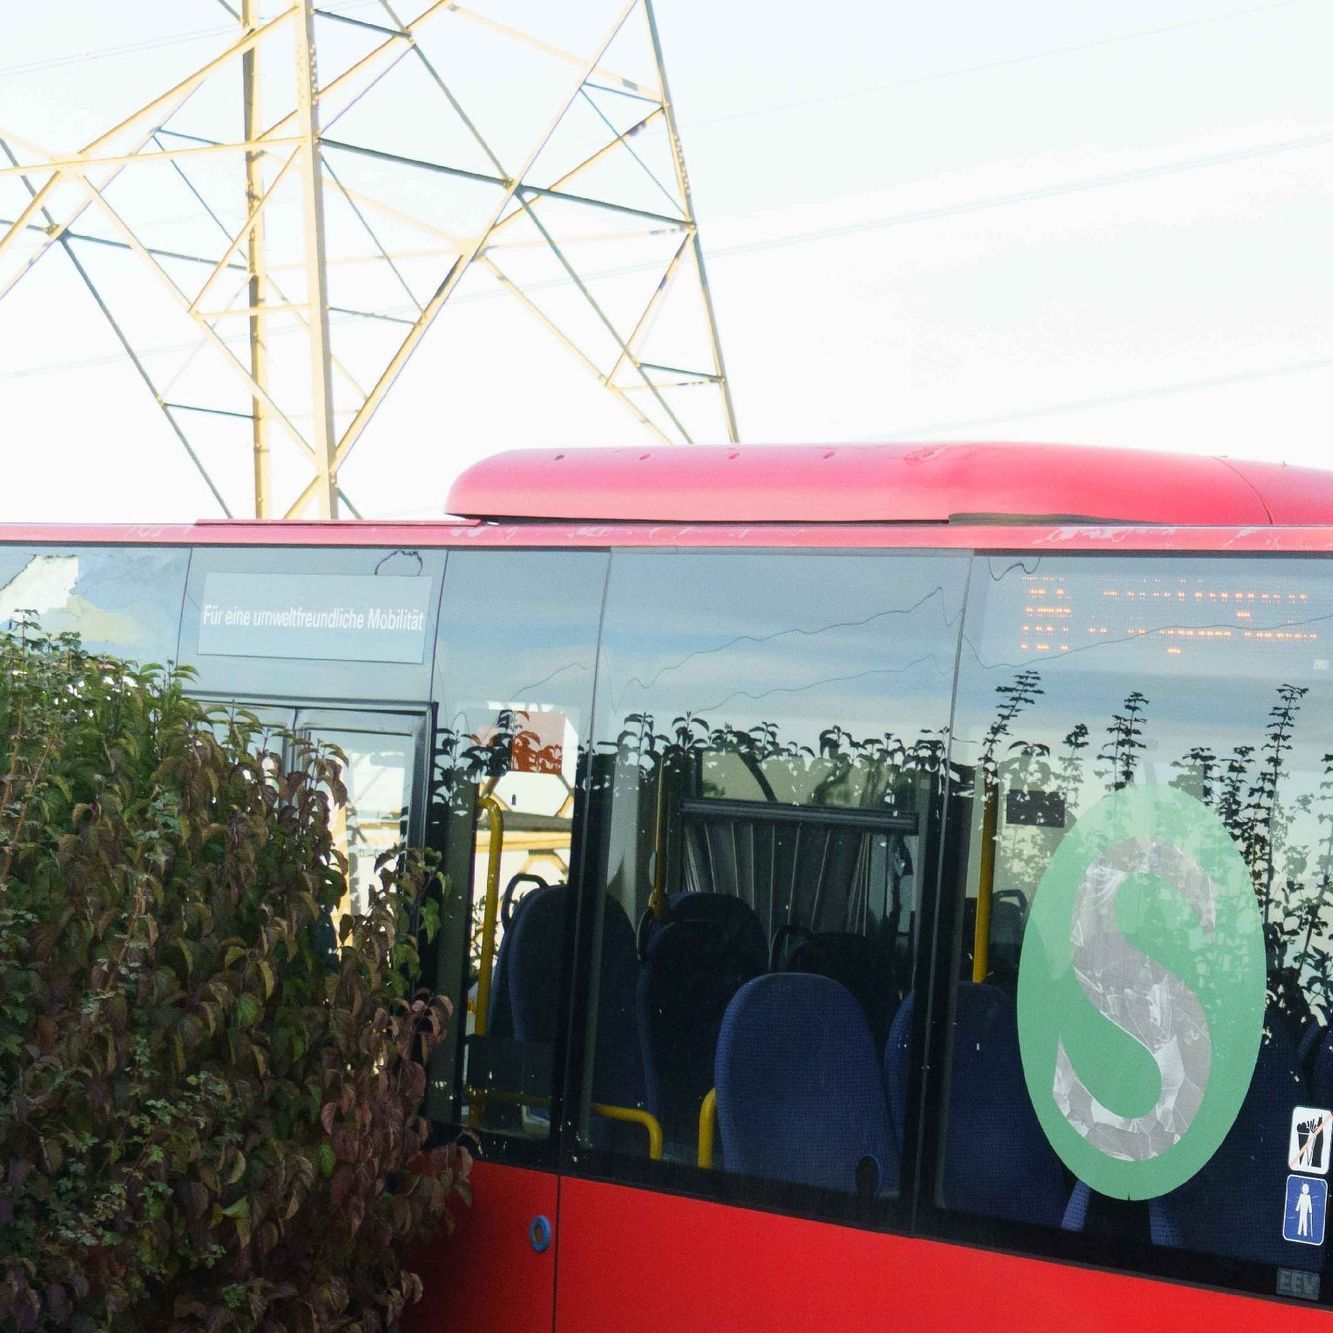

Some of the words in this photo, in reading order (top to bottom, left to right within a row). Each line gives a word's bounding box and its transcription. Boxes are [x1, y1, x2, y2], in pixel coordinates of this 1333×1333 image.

[202, 604, 224, 625] Für
[225, 606, 250, 626] eine
[253, 606, 364, 629] umweltfreundliche
[367, 607, 424, 631] Mobilität
[1053, 836, 1216, 1161] S
